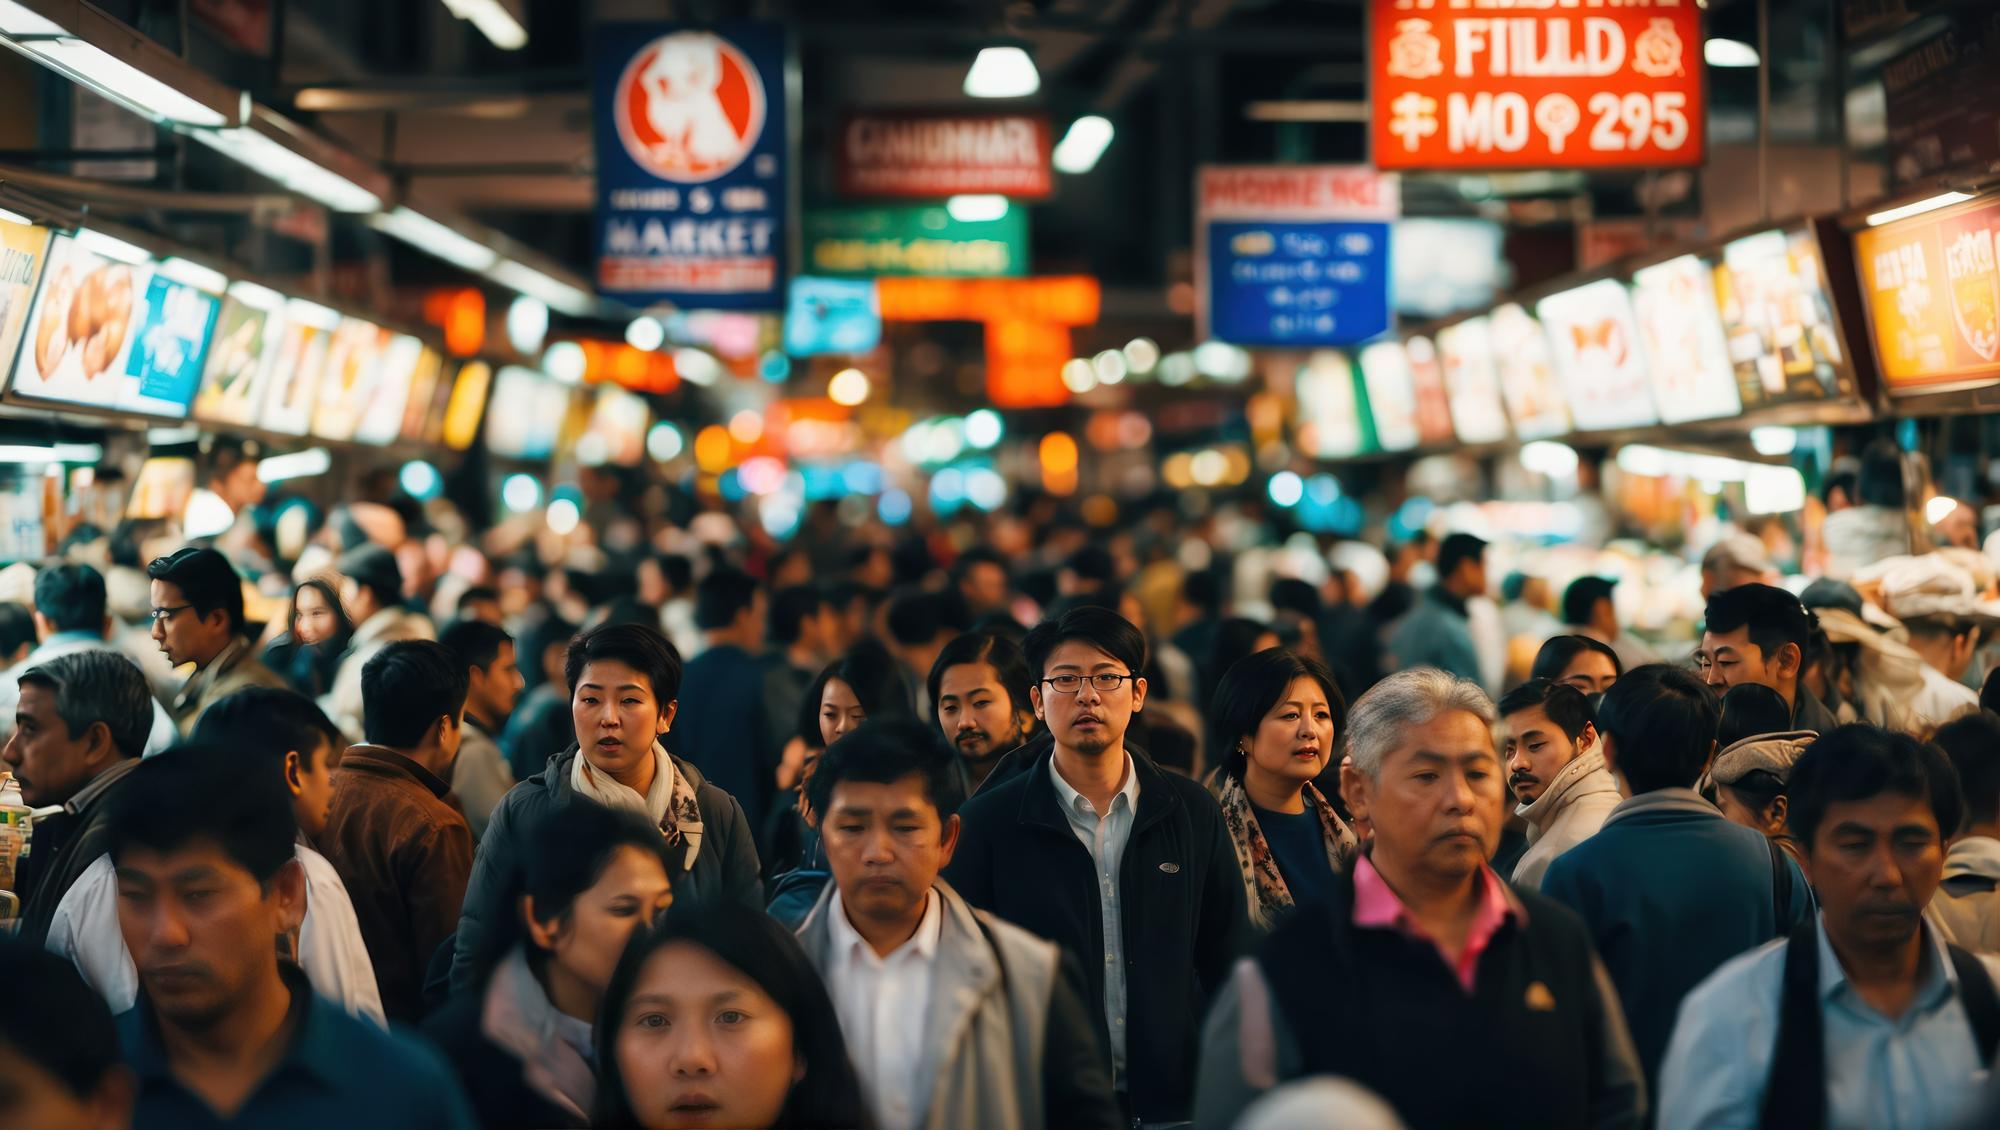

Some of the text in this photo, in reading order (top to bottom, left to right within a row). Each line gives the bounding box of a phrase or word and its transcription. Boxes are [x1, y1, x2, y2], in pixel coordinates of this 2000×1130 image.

[1446, 91, 1688, 152] MO 295
[605, 218, 774, 256] MARKET
